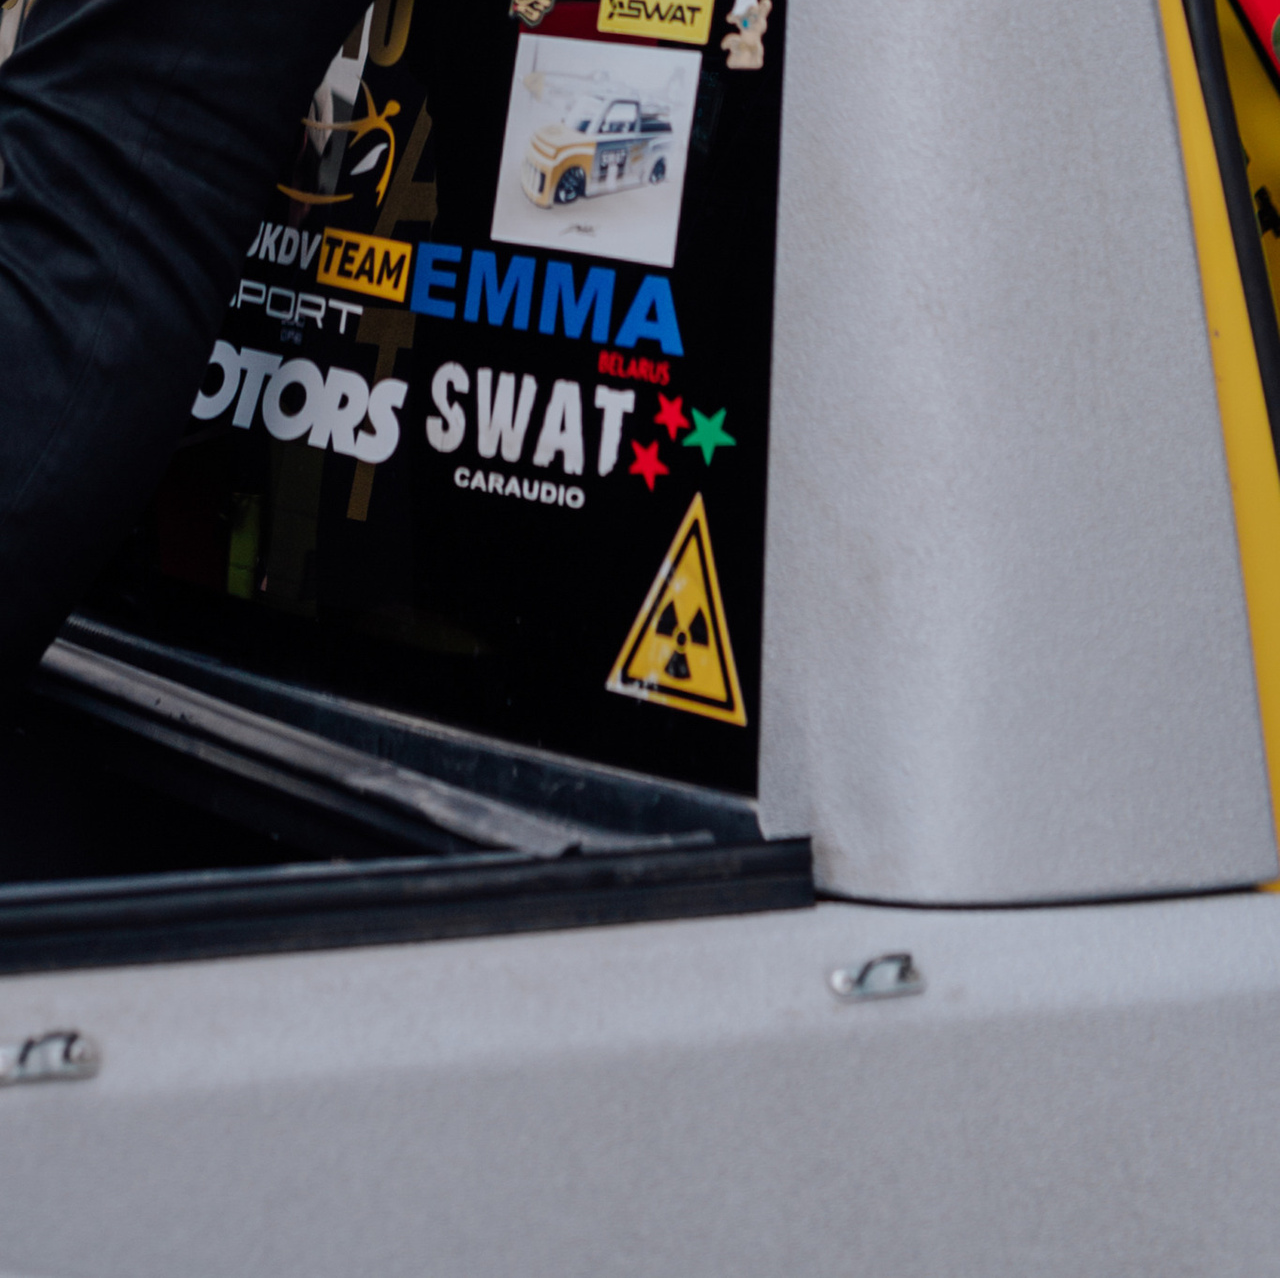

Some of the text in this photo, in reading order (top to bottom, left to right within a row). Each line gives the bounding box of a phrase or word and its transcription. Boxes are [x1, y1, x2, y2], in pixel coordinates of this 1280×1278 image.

[618, 0, 701, 27] SWAT
[322, 234, 408, 290] TEAM
[229, 278, 364, 335] PORT
[410, 240, 685, 357] EMMA
[426, 360, 636, 477] SWAT
[453, 466, 586, 510] CARAUDIO
